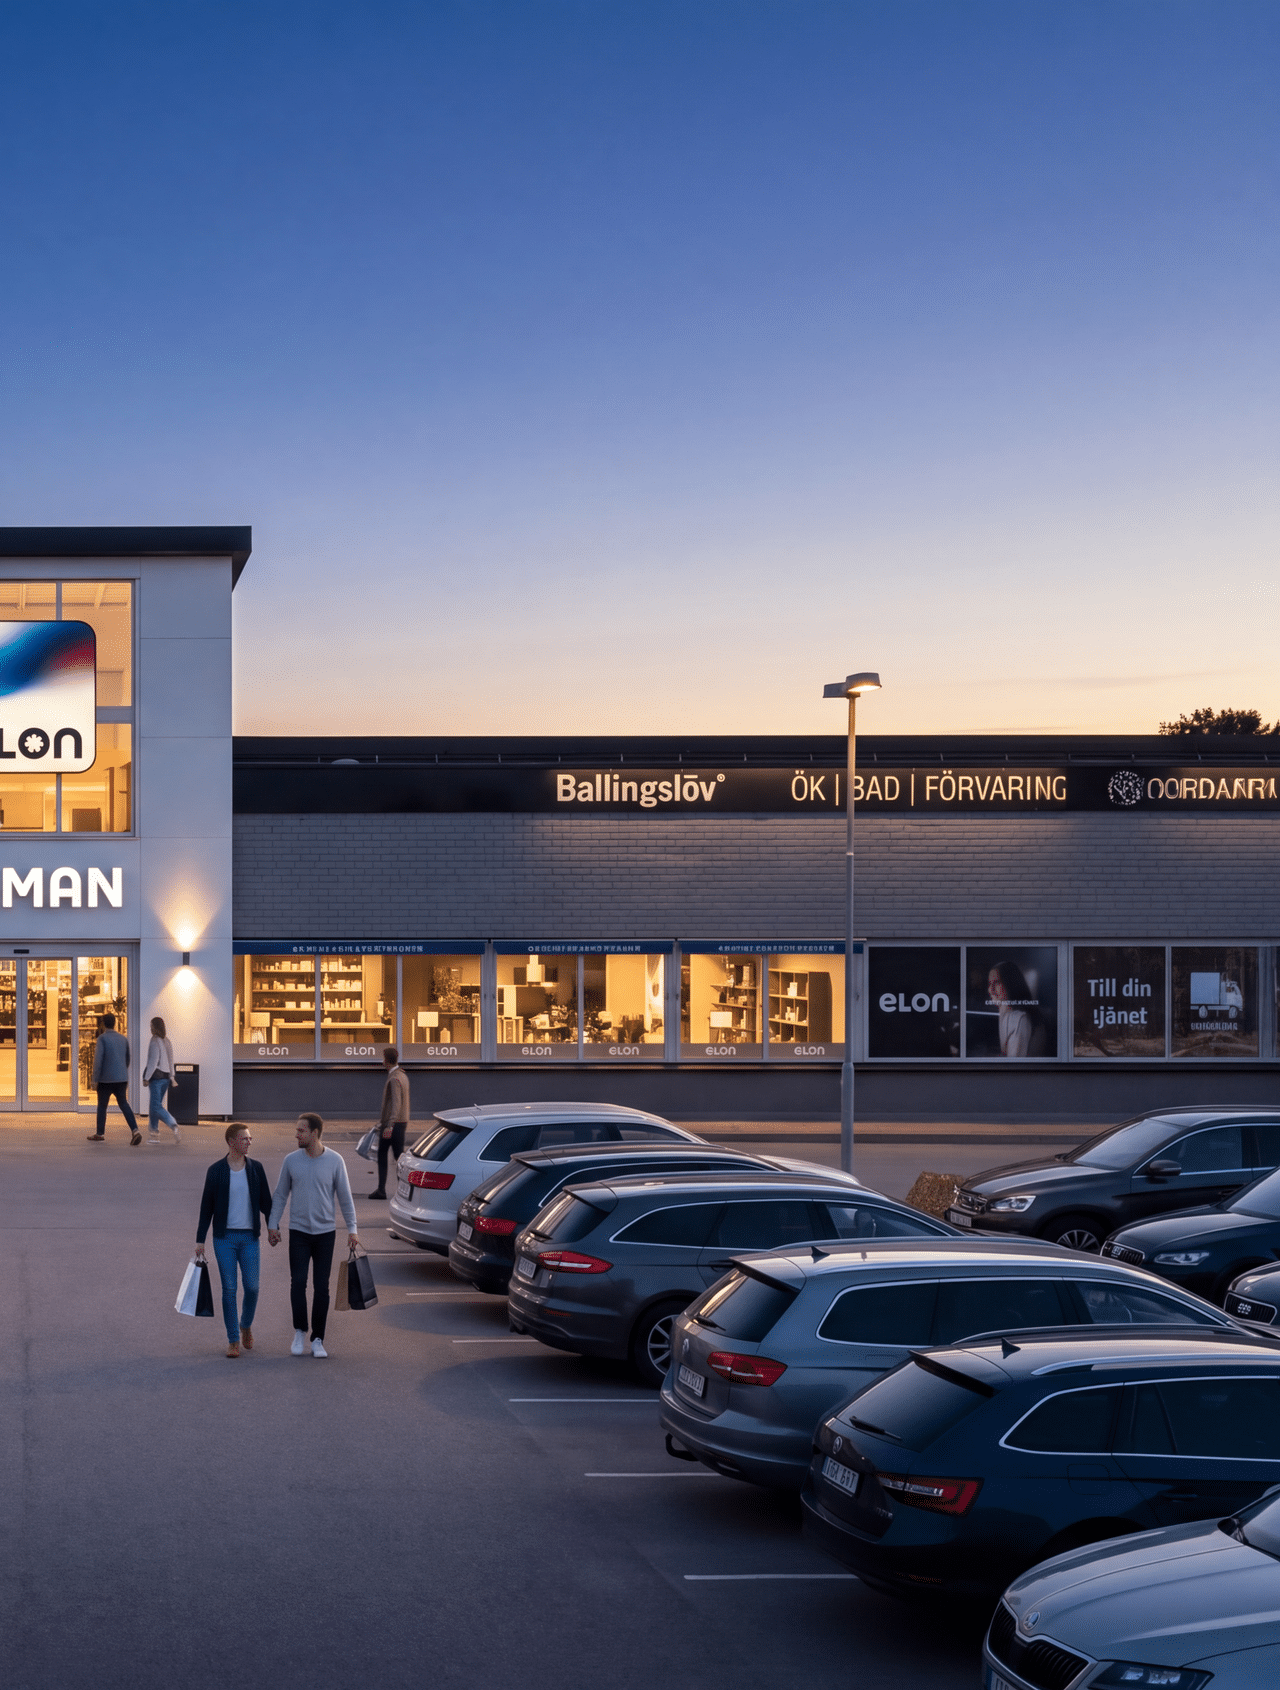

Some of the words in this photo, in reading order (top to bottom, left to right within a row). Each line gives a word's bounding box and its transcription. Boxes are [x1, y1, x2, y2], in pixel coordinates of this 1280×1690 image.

[791, 770, 826, 801] ÖK
[925, 770, 1067, 801] FÖRVARING
[1087, 978, 1117, 997] Till
[1122, 978, 1152, 997] din
